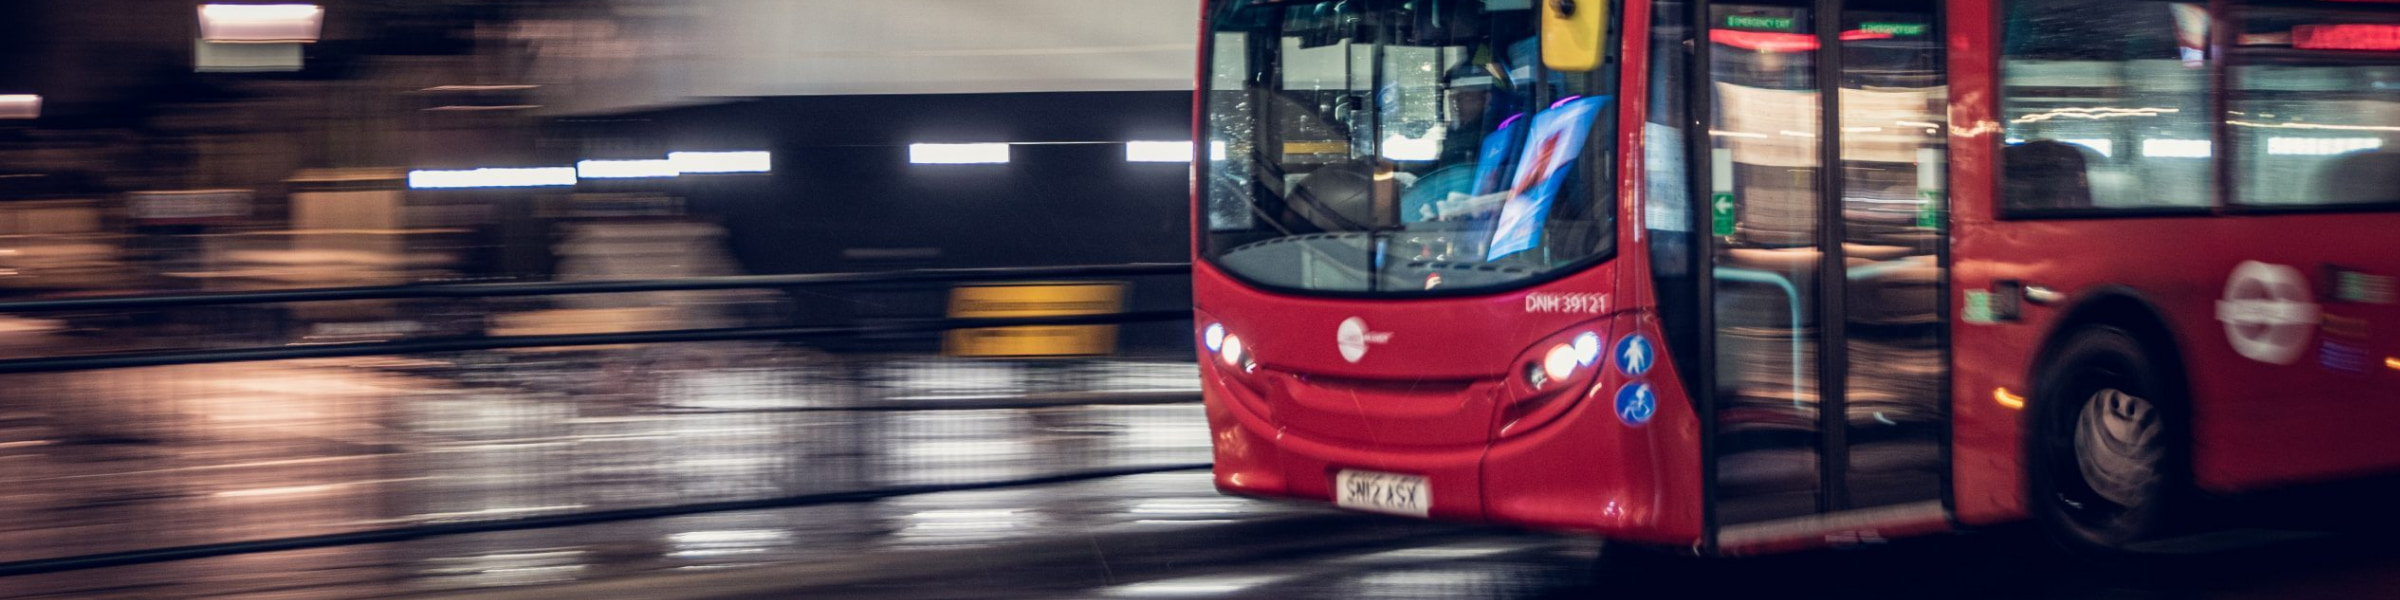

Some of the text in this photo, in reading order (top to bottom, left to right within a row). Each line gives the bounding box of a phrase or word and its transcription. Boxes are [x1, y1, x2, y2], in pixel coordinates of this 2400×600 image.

[1526, 293, 1606, 314] DNH 39121
[1346, 476, 1419, 511] SN12 ASX
